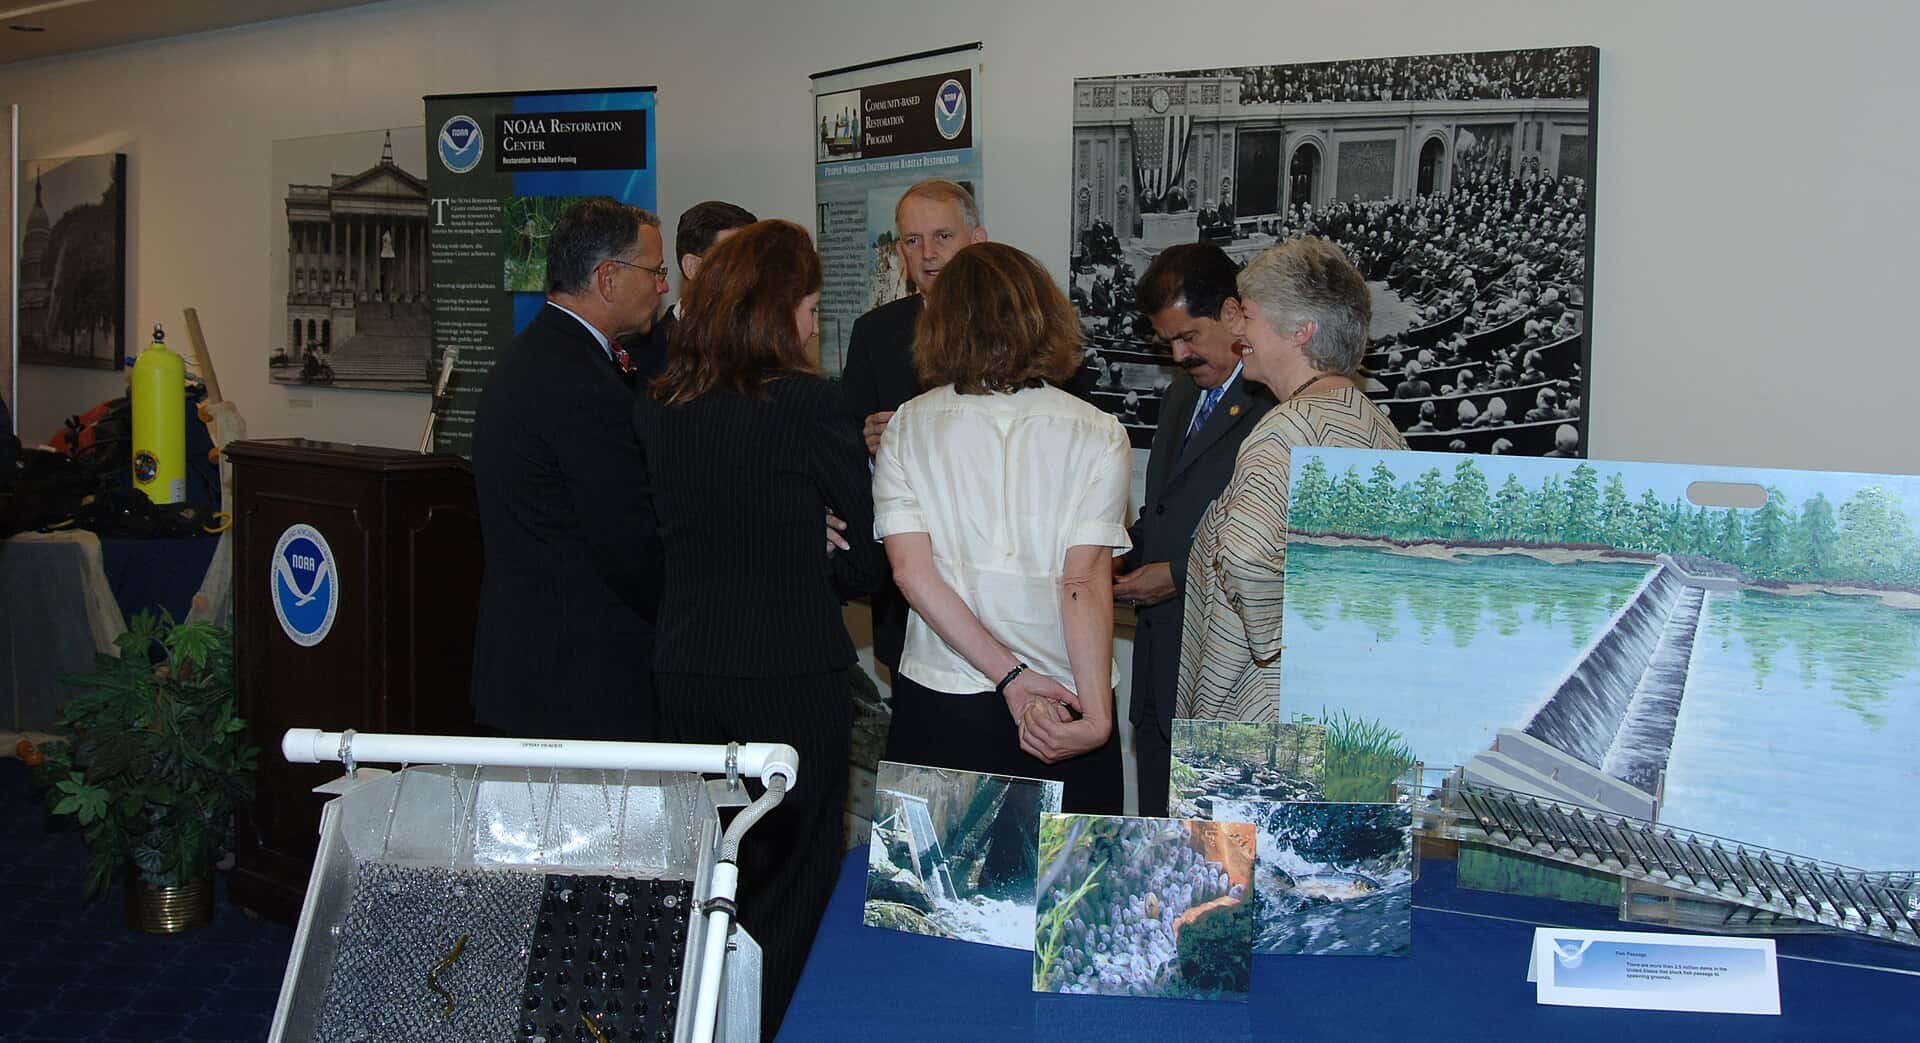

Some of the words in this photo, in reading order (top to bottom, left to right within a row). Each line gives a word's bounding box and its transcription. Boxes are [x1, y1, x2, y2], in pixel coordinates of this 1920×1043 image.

[503, 119, 546, 135] NOAA
[550, 118, 622, 134] RESTORATION
[866, 115, 905, 130] RESTORATION
[503, 137, 545, 152] CENTER
[866, 132, 894, 146] PROGRAM
[502, 156, 531, 165] Restoration
[292, 554, 315, 571] NOAA
